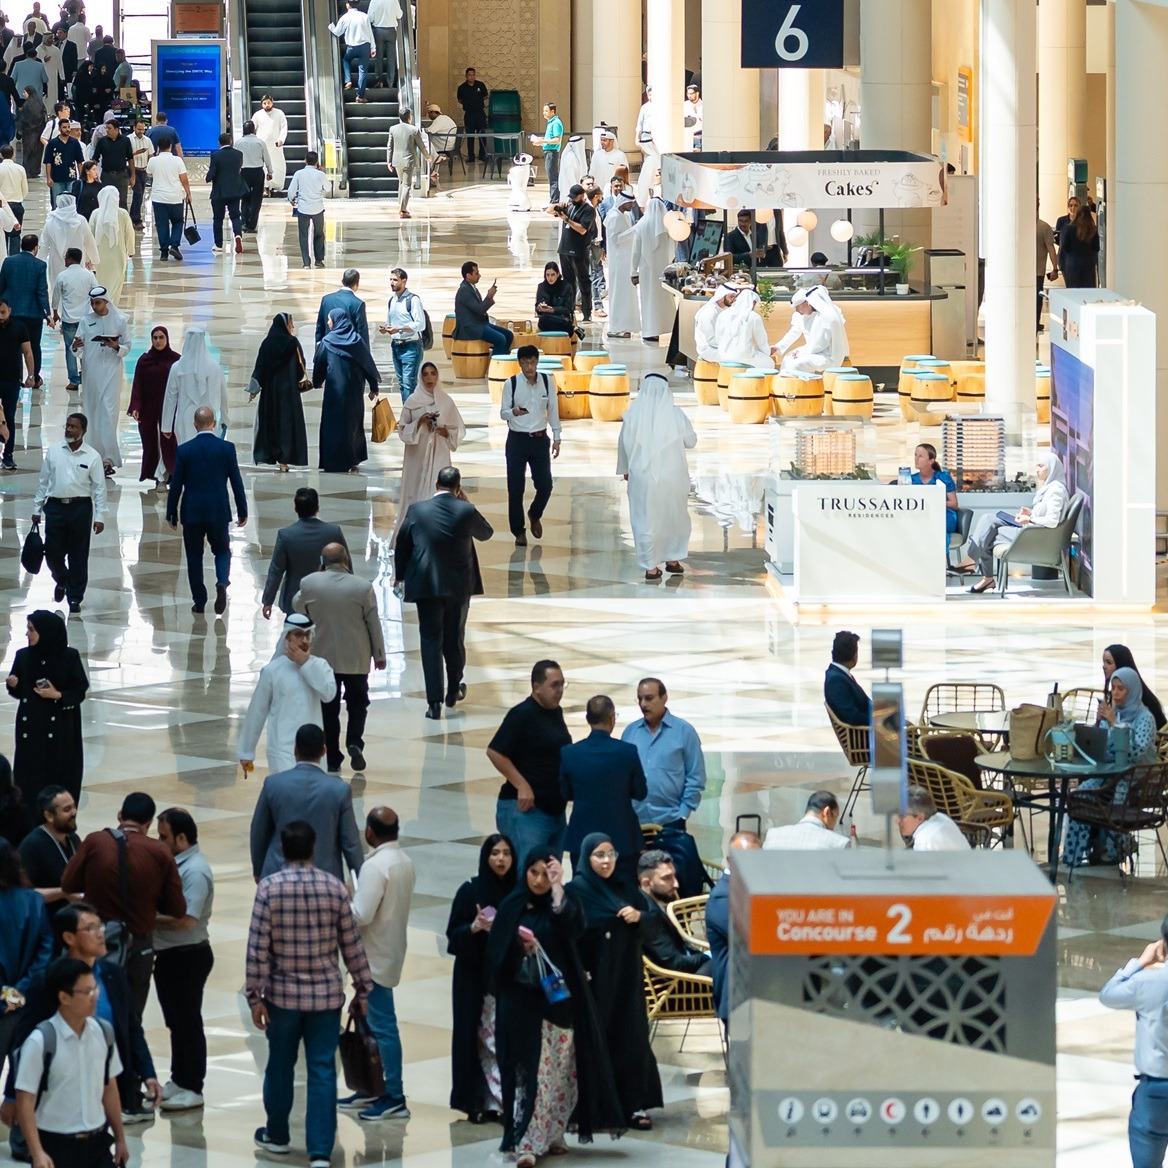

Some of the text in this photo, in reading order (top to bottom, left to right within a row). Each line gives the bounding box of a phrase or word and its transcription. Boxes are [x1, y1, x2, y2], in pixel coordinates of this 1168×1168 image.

[774, 4, 809, 62] 6
[824, 179, 879, 196] Cakes
[817, 497, 925, 511] TRUSSARDI
[776, 908, 855, 923] YOU ARE IN
[776, 902, 913, 945] Concourse 2
[922, 924, 964, 945] رقم
